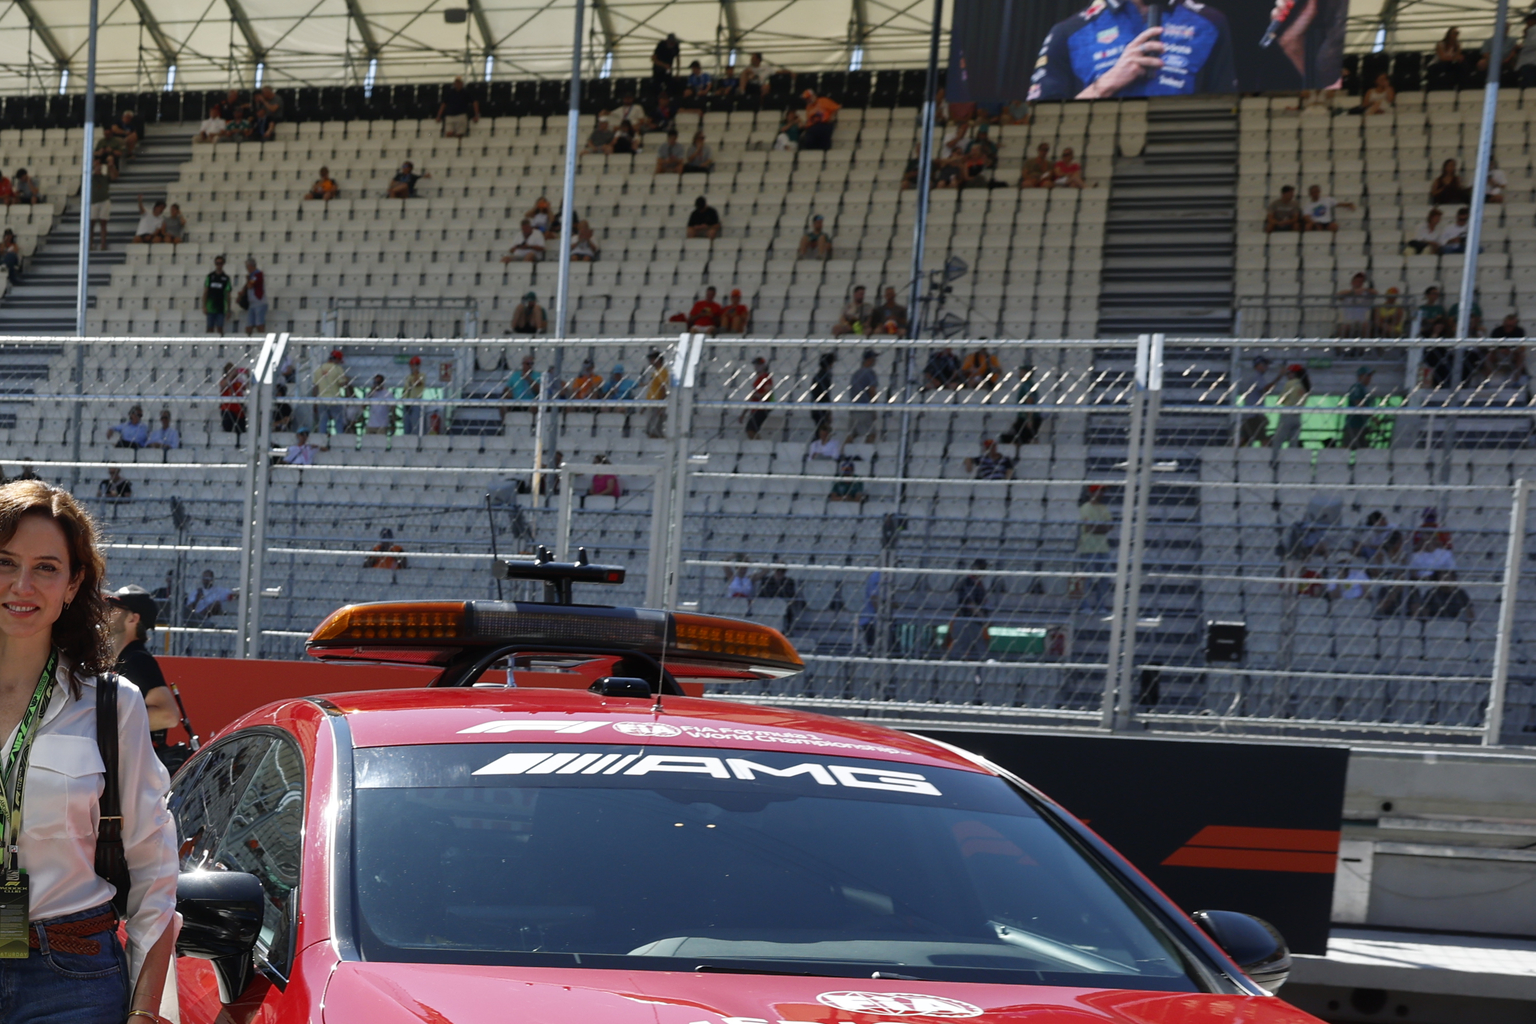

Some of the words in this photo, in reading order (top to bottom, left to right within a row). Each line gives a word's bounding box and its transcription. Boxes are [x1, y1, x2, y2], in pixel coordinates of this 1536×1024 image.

[680, 725, 722, 735] FIA
[724, 728, 805, 740] Formula
[686, 731, 751, 742] World
[753, 735, 897, 755] Championship
[624, 753, 943, 796] AMG
